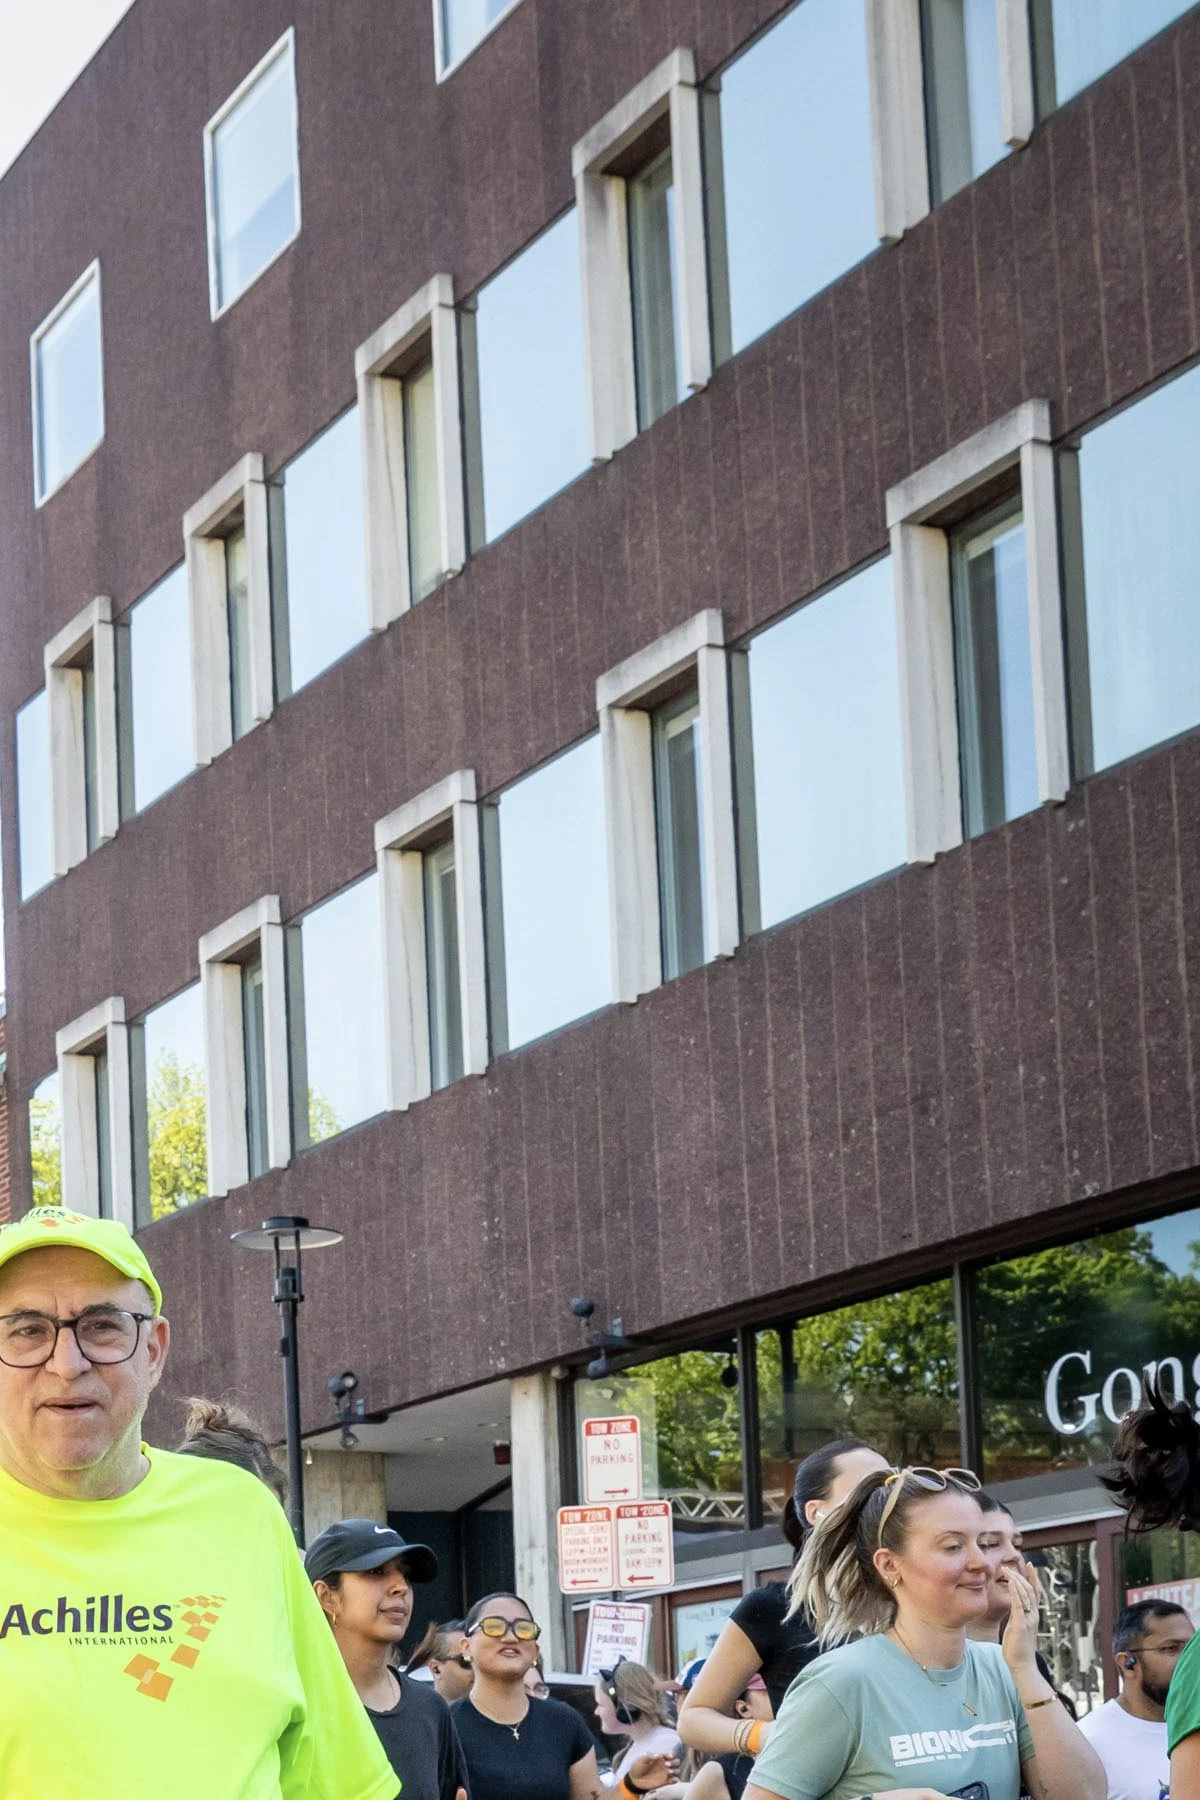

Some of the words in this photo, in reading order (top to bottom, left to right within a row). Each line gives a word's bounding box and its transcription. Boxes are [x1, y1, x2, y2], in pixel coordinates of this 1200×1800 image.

[603, 1438, 620, 1450] NO
[591, 1454, 634, 1465] PARKING
[563, 1511, 581, 1523] TOW
[584, 1510, 608, 1522] ZONE
[620, 1506, 639, 1517] TOW
[641, 1504, 666, 1516] ZONE
[637, 1520, 649, 1530] NO
[625, 1532, 663, 1544] PARKING
[611, 1623, 625, 1633] NO
[68, 1635, 175, 1646] INTERNATIONAL
[596, 1634, 638, 1646] PARKING
[889, 1721, 1006, 1761] BIONIC
